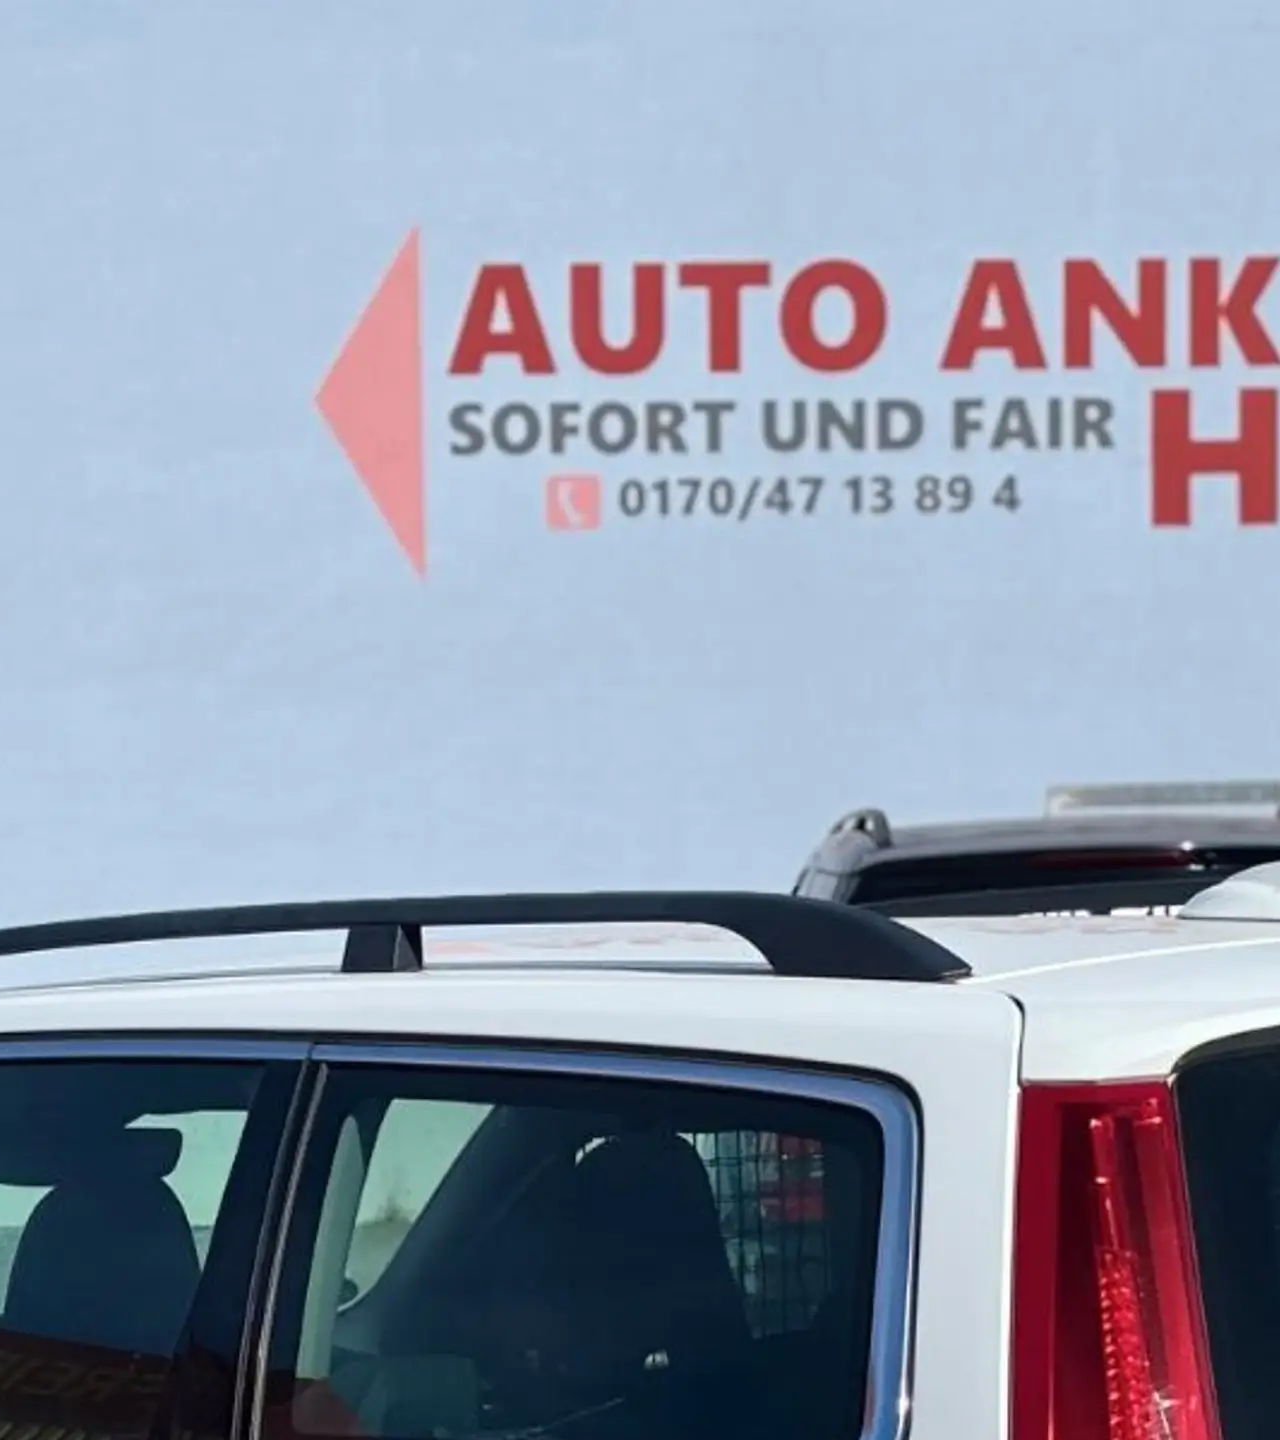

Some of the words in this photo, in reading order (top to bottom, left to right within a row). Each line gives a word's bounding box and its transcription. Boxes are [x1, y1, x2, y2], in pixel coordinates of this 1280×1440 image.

[450, 260, 888, 376] AUTO
[449, 400, 736, 457] SOFORT
[762, 399, 925, 454] UND
[952, 397, 1115, 451] FAIR
[618, 475, 826, 521] 0170/47
[844, 475, 894, 514] 13
[914, 475, 975, 514] 89
[992, 475, 1021, 513] 4
